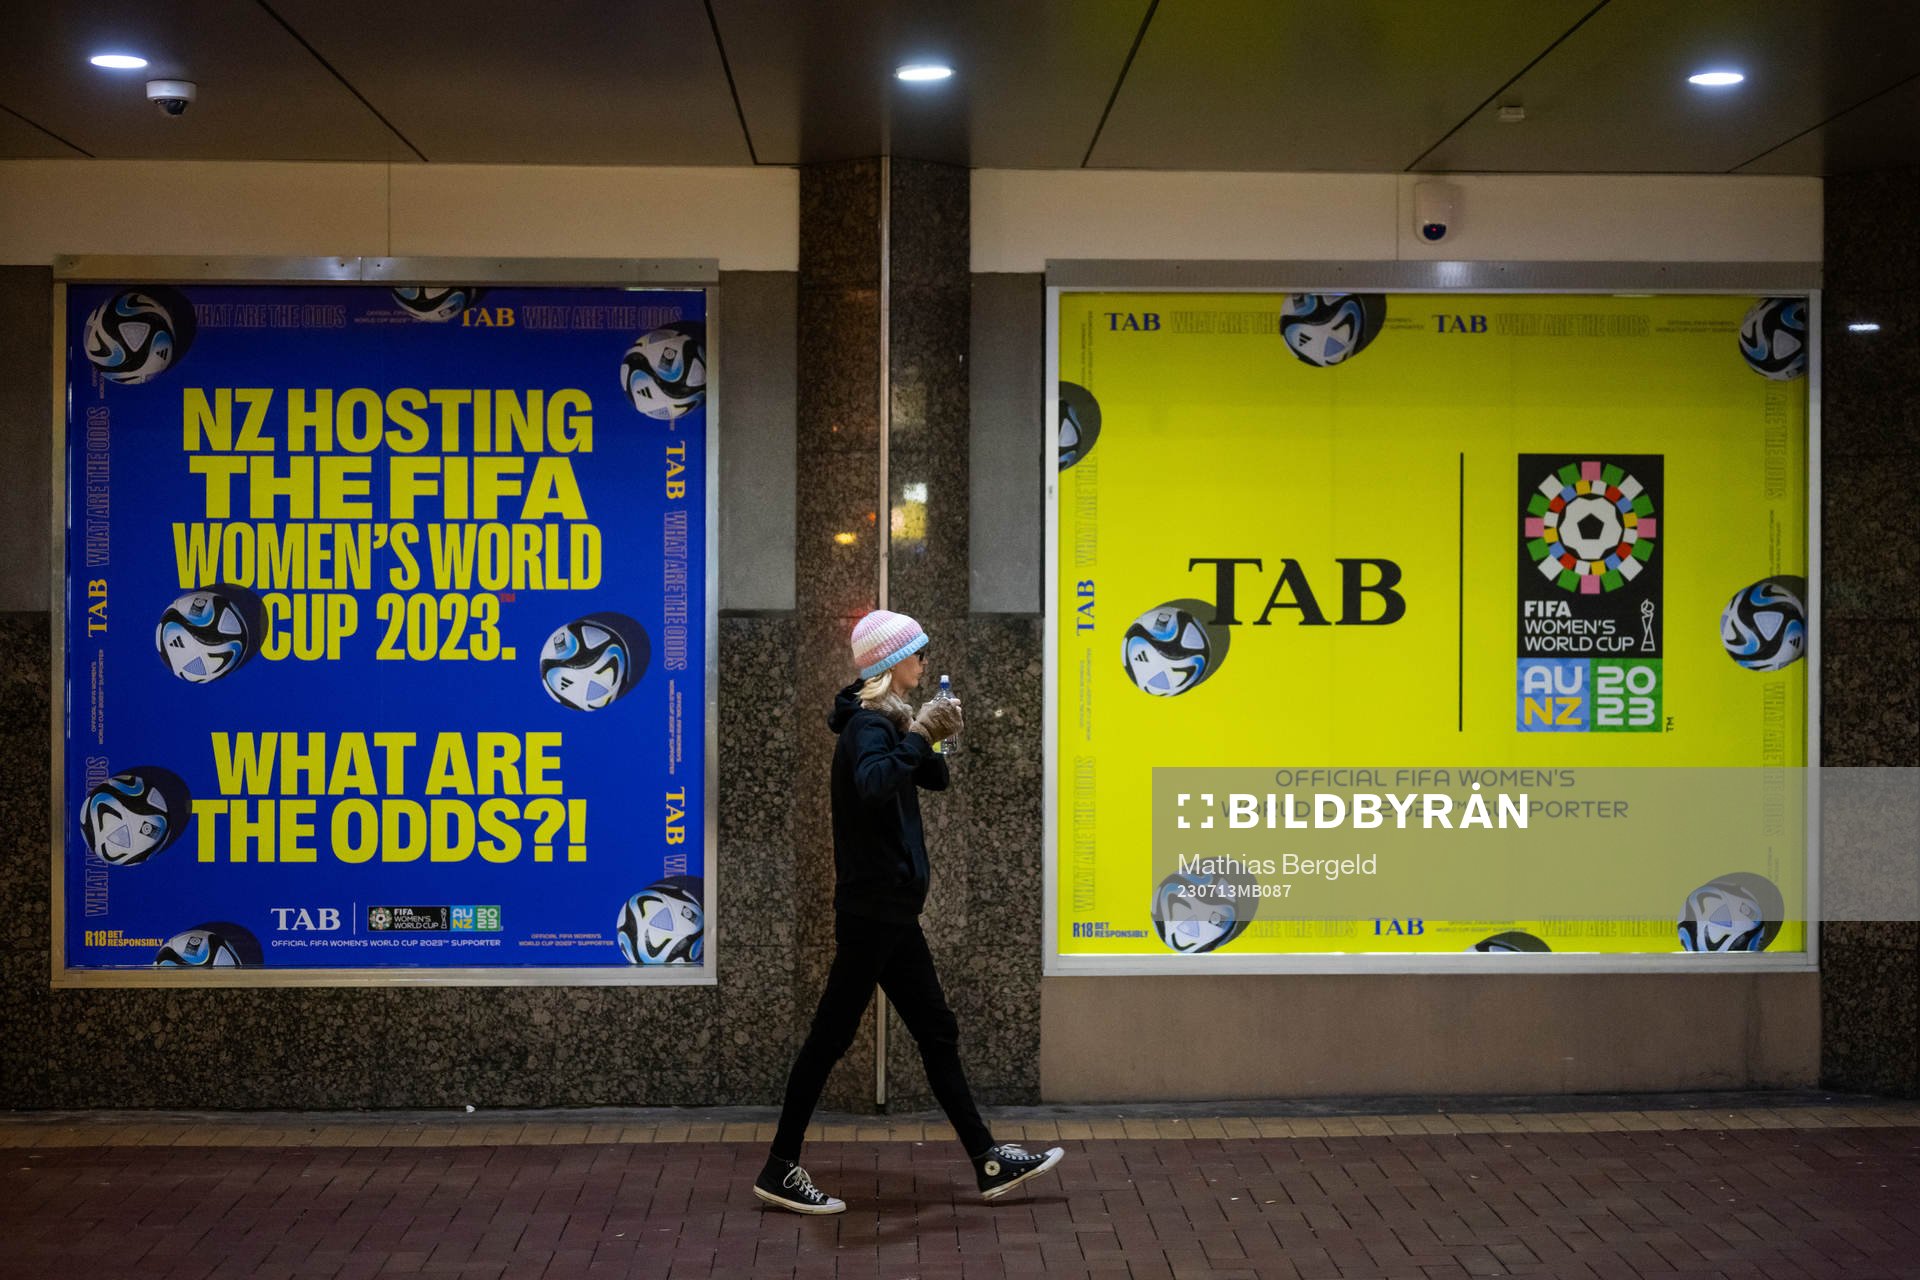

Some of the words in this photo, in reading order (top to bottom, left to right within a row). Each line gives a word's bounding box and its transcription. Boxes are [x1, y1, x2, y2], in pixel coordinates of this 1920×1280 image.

[461, 307, 515, 327] TAB
[1104, 313, 1161, 331] TAB
[1432, 314, 1488, 334] TAB
[184, 388, 275, 452] NZ
[288, 388, 593, 453] HOSTING
[666, 441, 686, 499] TAB
[190, 456, 373, 519] THE
[390, 456, 588, 520] FIFA
[173, 522, 421, 591] WOMEN’S
[428, 523, 602, 591] WORLD
[1188, 558, 1406, 626] TAB
[87, 579, 108, 637] TAB
[1076, 579, 1095, 636] TAB
[1524, 600, 1572, 617] FIFA
[260, 593, 358, 661] CUP
[376, 593, 516, 661] 2023.
[1524, 619, 1616, 634] WOMEN'S
[1524, 636, 1593, 651] WORLD
[1596, 636, 1635, 651] CUP
[1523, 665, 1583, 694] AU
[1597, 665, 1656, 695] 20
[1523, 697, 1583, 725] NZ
[1597, 697, 1656, 725] 23
[211, 732, 417, 795] WHAT
[426, 732, 563, 795] ARE
[1275, 769, 1387, 787] OFFICIAL
[1396, 769, 1450, 787] FIFA
[1459, 769, 1576, 787] WOMEN'S
[666, 786, 686, 845] TAB
[192, 799, 317, 863] THE
[332, 798, 587, 864] ODDS?!
[86, 869, 109, 917] WHAT
[270, 908, 342, 931] TAB
[393, 908, 414, 916] FIFA
[452, 908, 473, 918] AU
[477, 908, 498, 918] 20
[393, 922, 422, 930] WORLD
[423, 922, 439, 930] CUP
[452, 919, 473, 929] NZ
[477, 919, 498, 929] 23
[1073, 922, 1093, 938] R18
[1368, 917, 1424, 935] TAB
[85, 930, 107, 947] R18
[107, 930, 123, 938] BET
[107, 938, 163, 947] RESPONSIBLY
